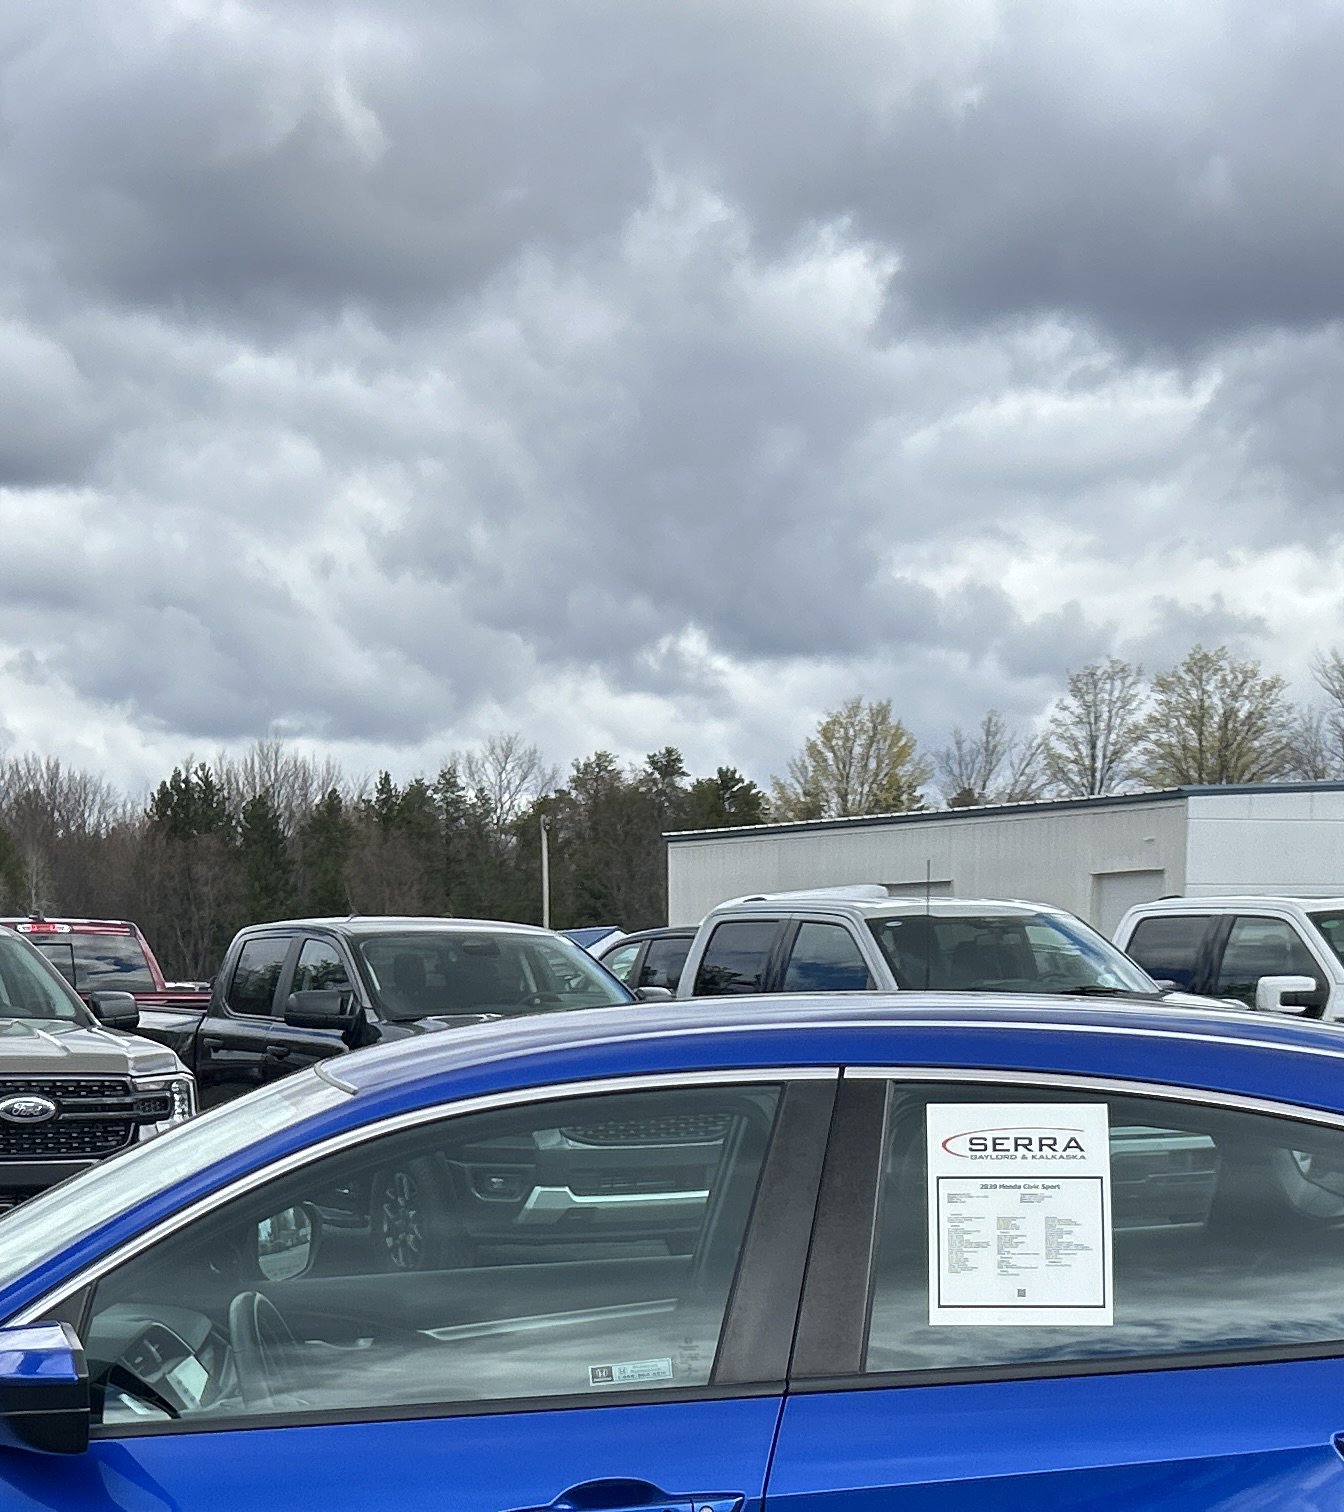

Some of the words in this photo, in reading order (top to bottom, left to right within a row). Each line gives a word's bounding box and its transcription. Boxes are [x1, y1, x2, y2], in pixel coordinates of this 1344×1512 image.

[11, 1102, 44, 1116] Ford
[968, 1136, 1086, 1153] SERRA
[1041, 1183, 1061, 1191] Sport
